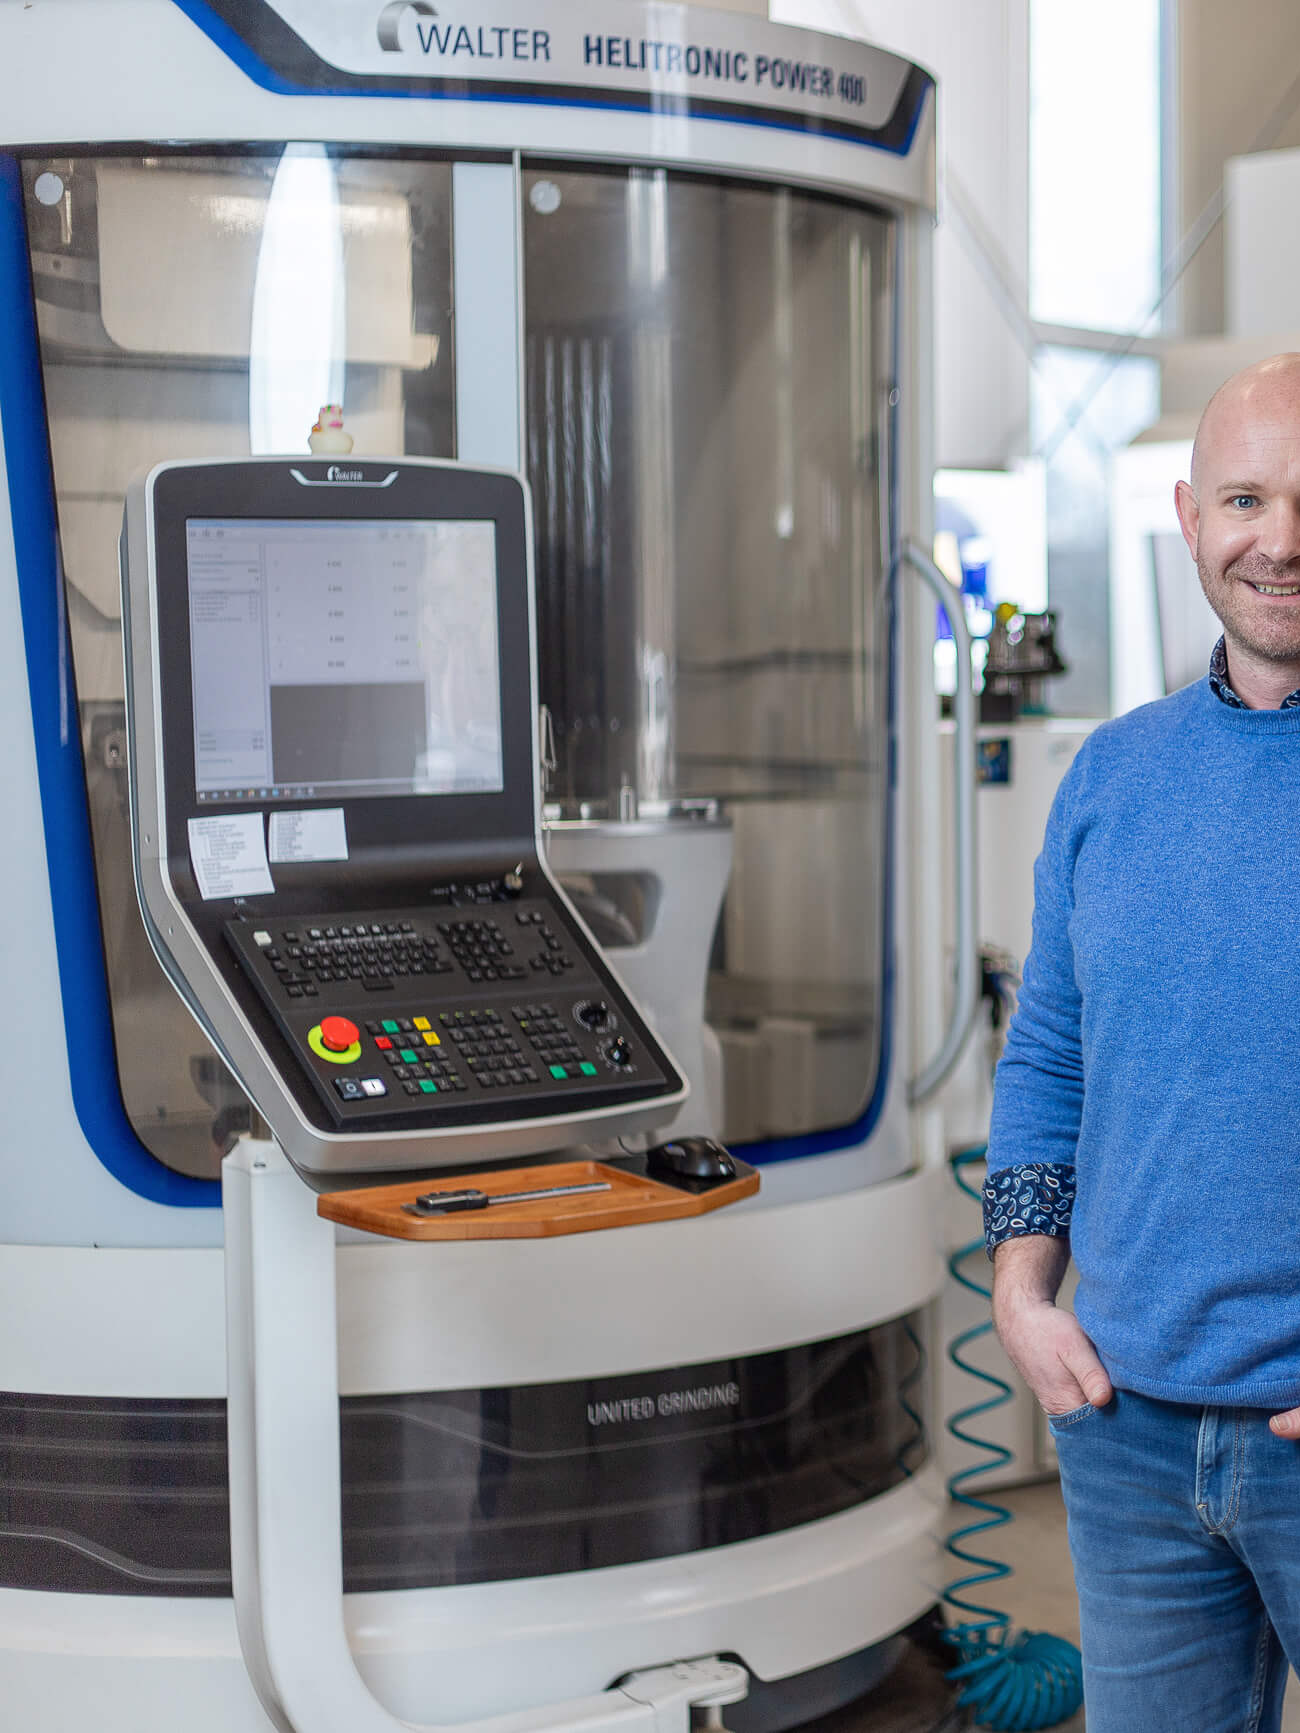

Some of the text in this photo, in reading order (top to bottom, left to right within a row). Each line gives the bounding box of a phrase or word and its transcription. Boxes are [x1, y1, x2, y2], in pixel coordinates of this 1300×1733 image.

[416, 22, 551, 61] WALTER
[584, 34, 749, 83] HELITRONIC
[755, 54, 834, 99] POWER
[587, 1381, 740, 1426] UNITED GRINDING
